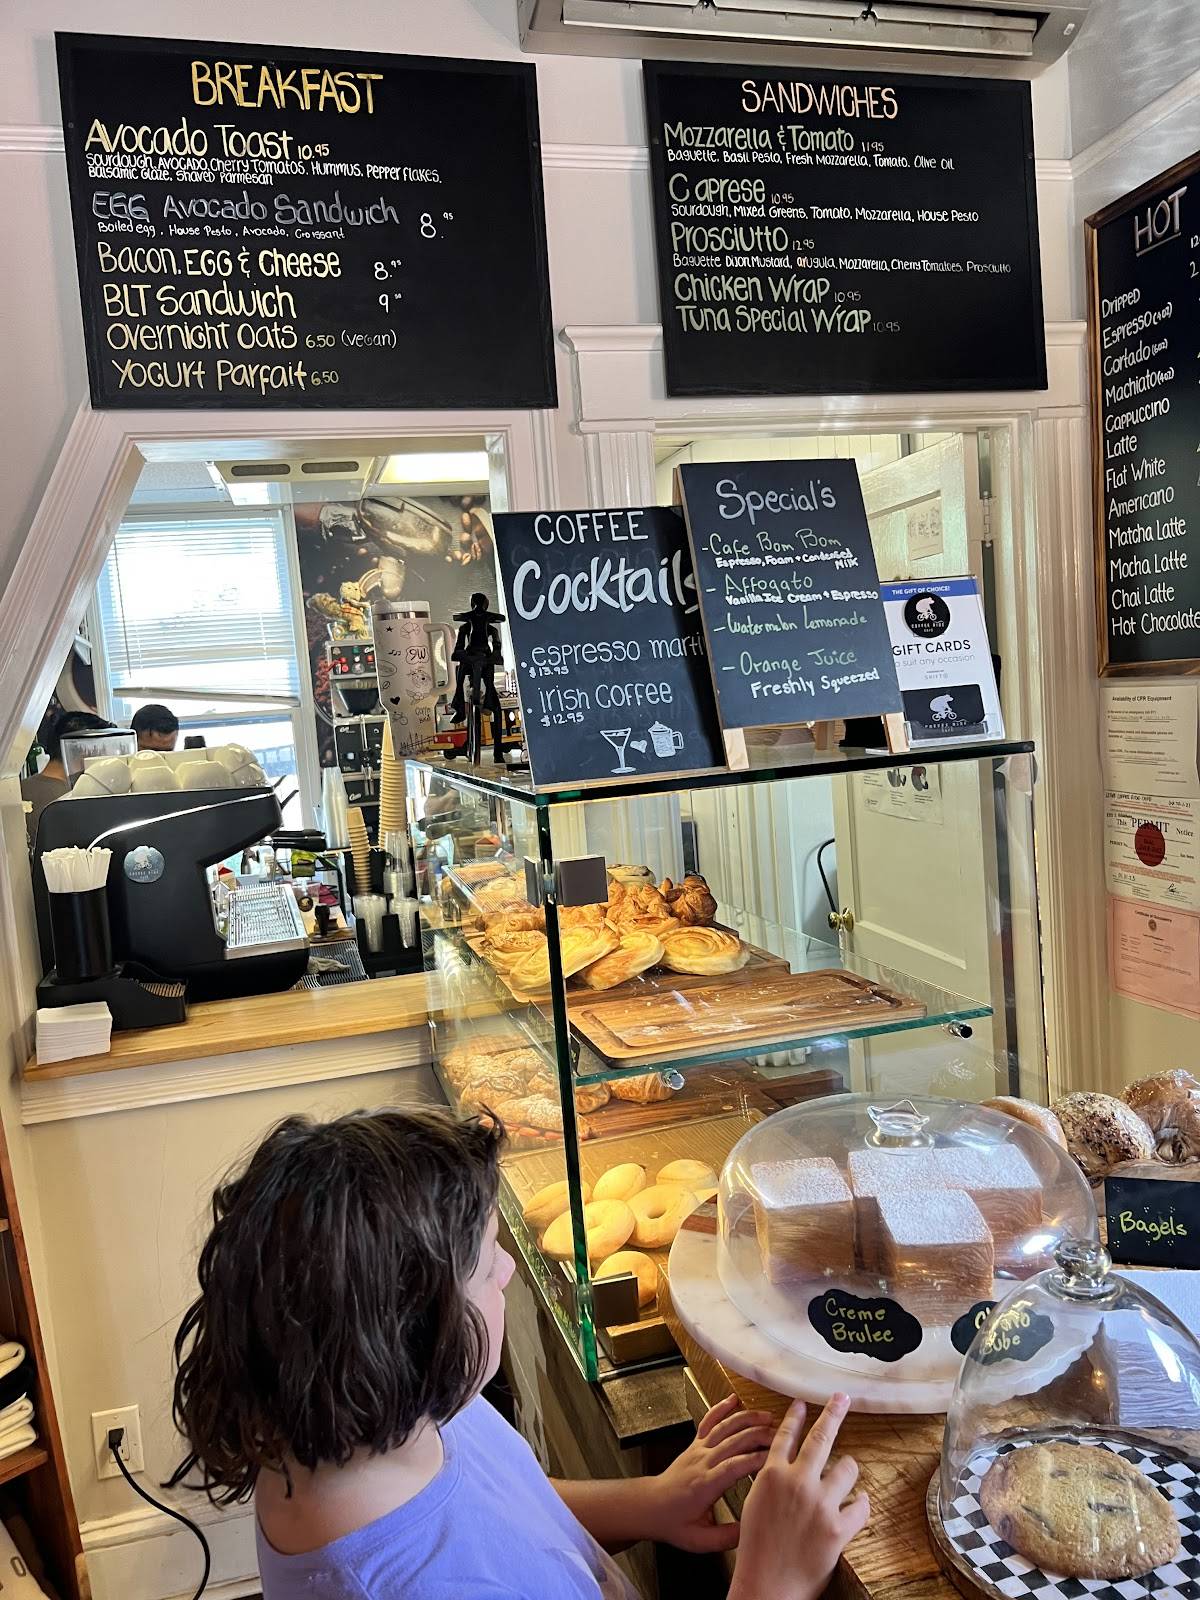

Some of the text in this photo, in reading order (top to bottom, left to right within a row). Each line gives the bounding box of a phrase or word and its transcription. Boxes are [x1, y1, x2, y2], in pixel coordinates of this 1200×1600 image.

[191, 60, 383, 114] BREAKFAST
[741, 79, 898, 119] SANDWICHES
[84, 116, 330, 160] Avocado Toast 10.95
[663, 121, 773, 150] Mozzarella
[776, 125, 787, 152] &
[787, 125, 854, 152] Tomato
[88, 166, 138, 179] Balsamic
[220, 172, 274, 186] Parmesan
[210, 157, 249, 172] Cherry
[723, 151, 750, 164] Basil
[785, 152, 814, 165] Fresh
[914, 155, 937, 169] Olive
[940, 158, 955, 170] Oil
[92, 190, 150, 223] EGG
[163, 190, 268, 221] Avocado
[274, 190, 400, 226] Sandwich
[733, 204, 766, 217] Mixed
[917, 209, 949, 222] House
[951, 209, 980, 222] Pesto
[1134, 185, 1187, 251] HOT
[98, 219, 134, 233] Boiled
[169, 224, 200, 236] House
[295, 227, 345, 240] Croissant
[670, 221, 789, 252] Prosciutto
[186, 248, 232, 277] EGG
[238, 246, 251, 279] &
[258, 249, 342, 279] Cheese
[102, 283, 151, 318] BLT
[156, 280, 297, 319] Sandwich
[674, 272, 763, 302] Chicken
[767, 273, 830, 303] Wrap
[675, 305, 732, 333] Tuna
[735, 305, 808, 333] Special
[811, 304, 871, 333] Wrap
[237, 321, 298, 350] Oats
[216, 360, 307, 396] Parfait
[1105, 397, 1170, 434] Cappuccino
[1106, 434, 1138, 460] Latte
[1106, 457, 1166, 493] Flat White
[715, 479, 836, 526] Special's
[1108, 486, 1174, 521] Americano
[534, 510, 649, 545] COFFEE
[756, 531, 795, 552] Bom
[795, 528, 842, 549] Bom
[1109, 516, 1187, 550] Matcha Latte
[765, 555, 794, 566] Foam
[1110, 549, 1188, 583] Mocha Latte
[725, 570, 813, 597] Affogato
[725, 593, 763, 606] Vanilla
[787, 591, 822, 604] Cream
[830, 589, 879, 602] Espresso
[1111, 582, 1175, 610] Chai Latte
[803, 605, 868, 630] Lemonade
[1111, 616, 1137, 636] Hot
[531, 632, 704, 667] espresso marti
[892, 639, 971, 656] GIFT CARDS
[902, 658, 918, 667] suit
[919, 658, 935, 667] any
[938, 653, 975, 664] occasion
[529, 665, 569, 679] $13.95
[740, 648, 857, 679] Orange Juice
[750, 667, 881, 699] Freshly Squeezed
[540, 711, 585, 728] $12.95
[1119, 1210, 1188, 1241] Bagels
[825, 1298, 886, 1322] Creme
[831, 1322, 894, 1344] Brulee
